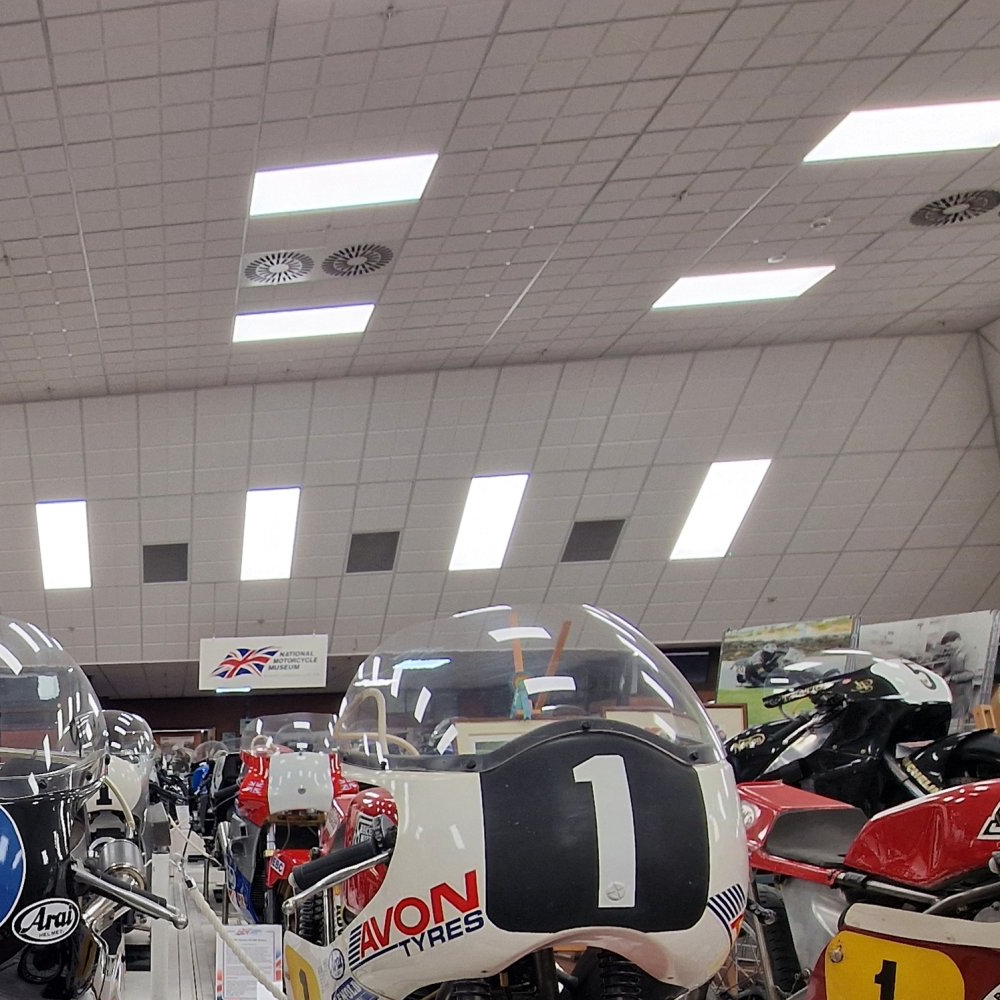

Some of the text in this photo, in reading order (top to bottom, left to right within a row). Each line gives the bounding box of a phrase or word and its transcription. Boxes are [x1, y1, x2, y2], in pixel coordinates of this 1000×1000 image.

[906, 662, 936, 690] 5
[573, 755, 636, 908] 1
[20, 903, 74, 933] Arai
[360, 870, 480, 958] AVON
[398, 910, 485, 957] TYRES
